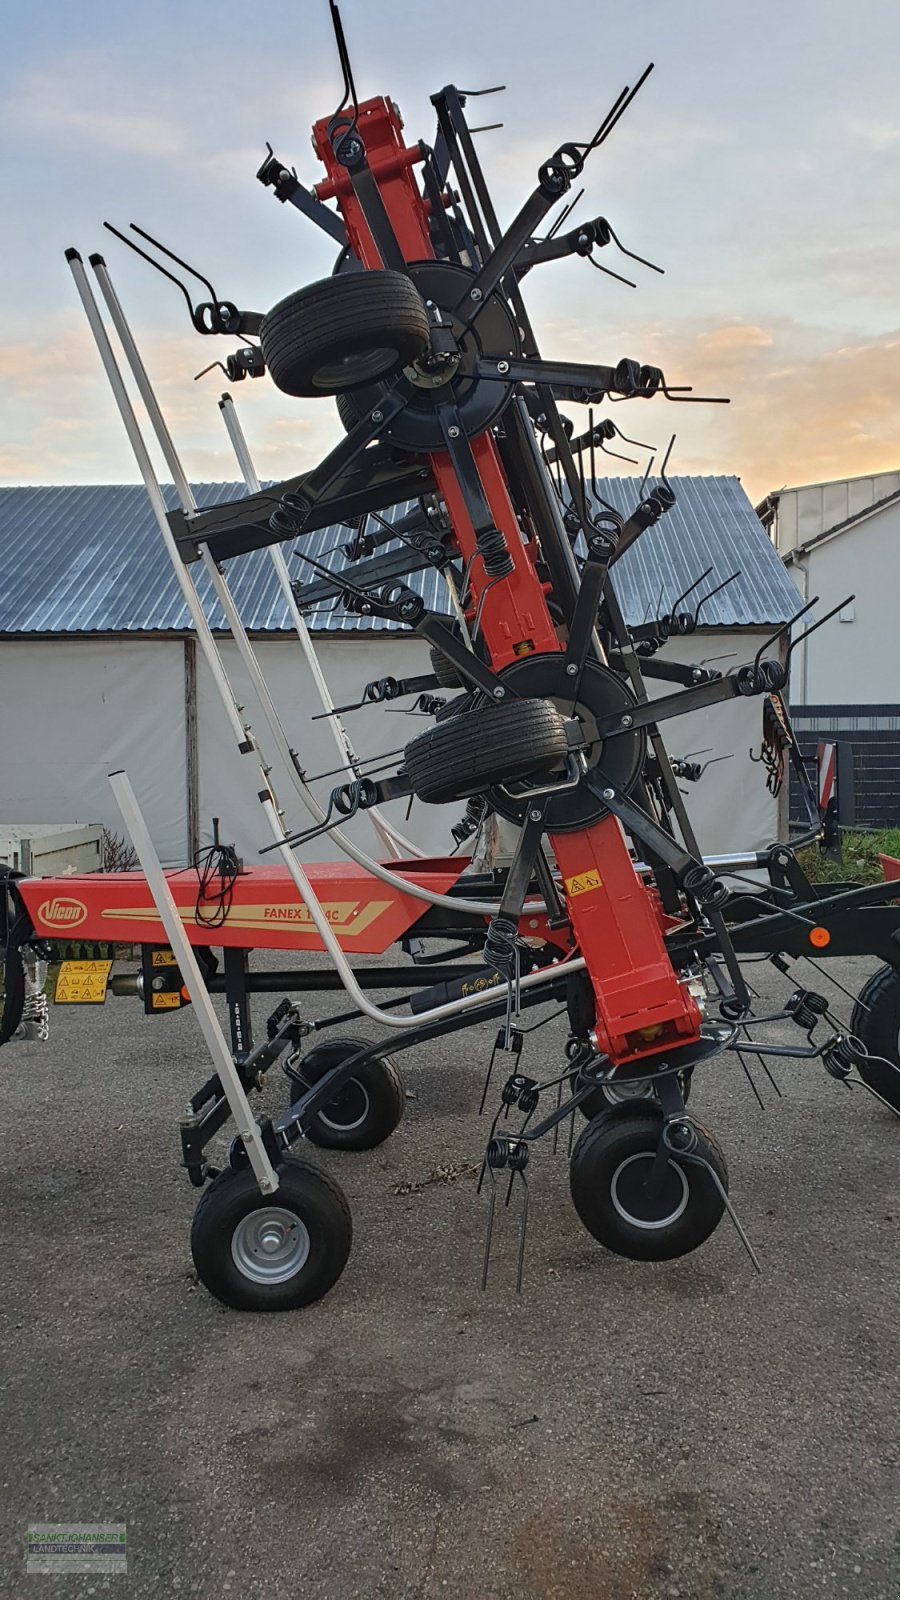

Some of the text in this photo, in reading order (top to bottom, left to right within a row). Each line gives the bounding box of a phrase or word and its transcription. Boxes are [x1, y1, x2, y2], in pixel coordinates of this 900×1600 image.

[44, 899, 82, 920] Vicon
[264, 908, 339, 920] FANEX 14C
